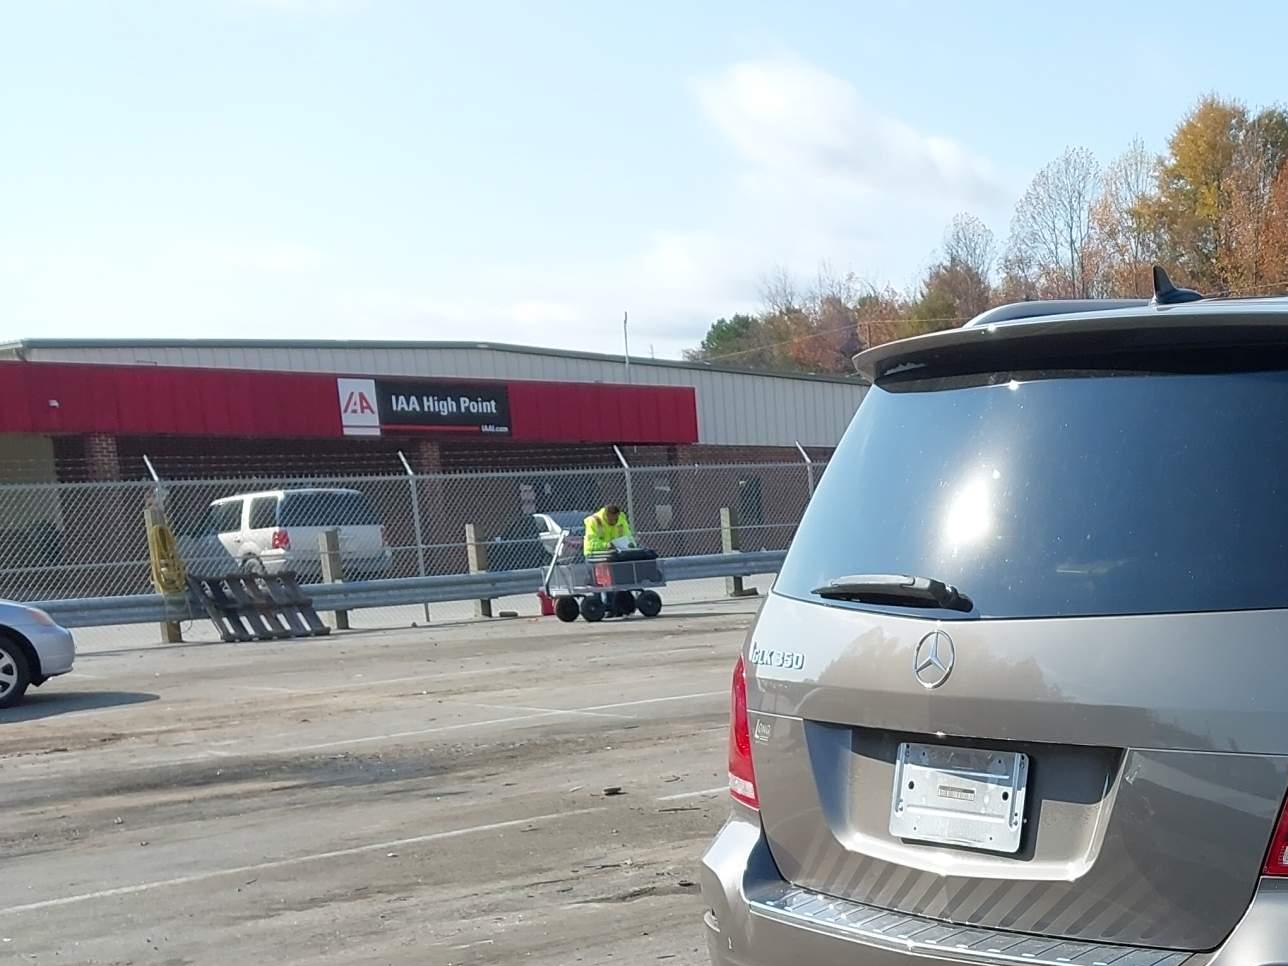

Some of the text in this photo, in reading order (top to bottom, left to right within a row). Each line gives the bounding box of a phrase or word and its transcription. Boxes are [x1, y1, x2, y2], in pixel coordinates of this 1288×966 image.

[391, 395, 497, 415] IAA High Point
[776, 650, 804, 670] 350
